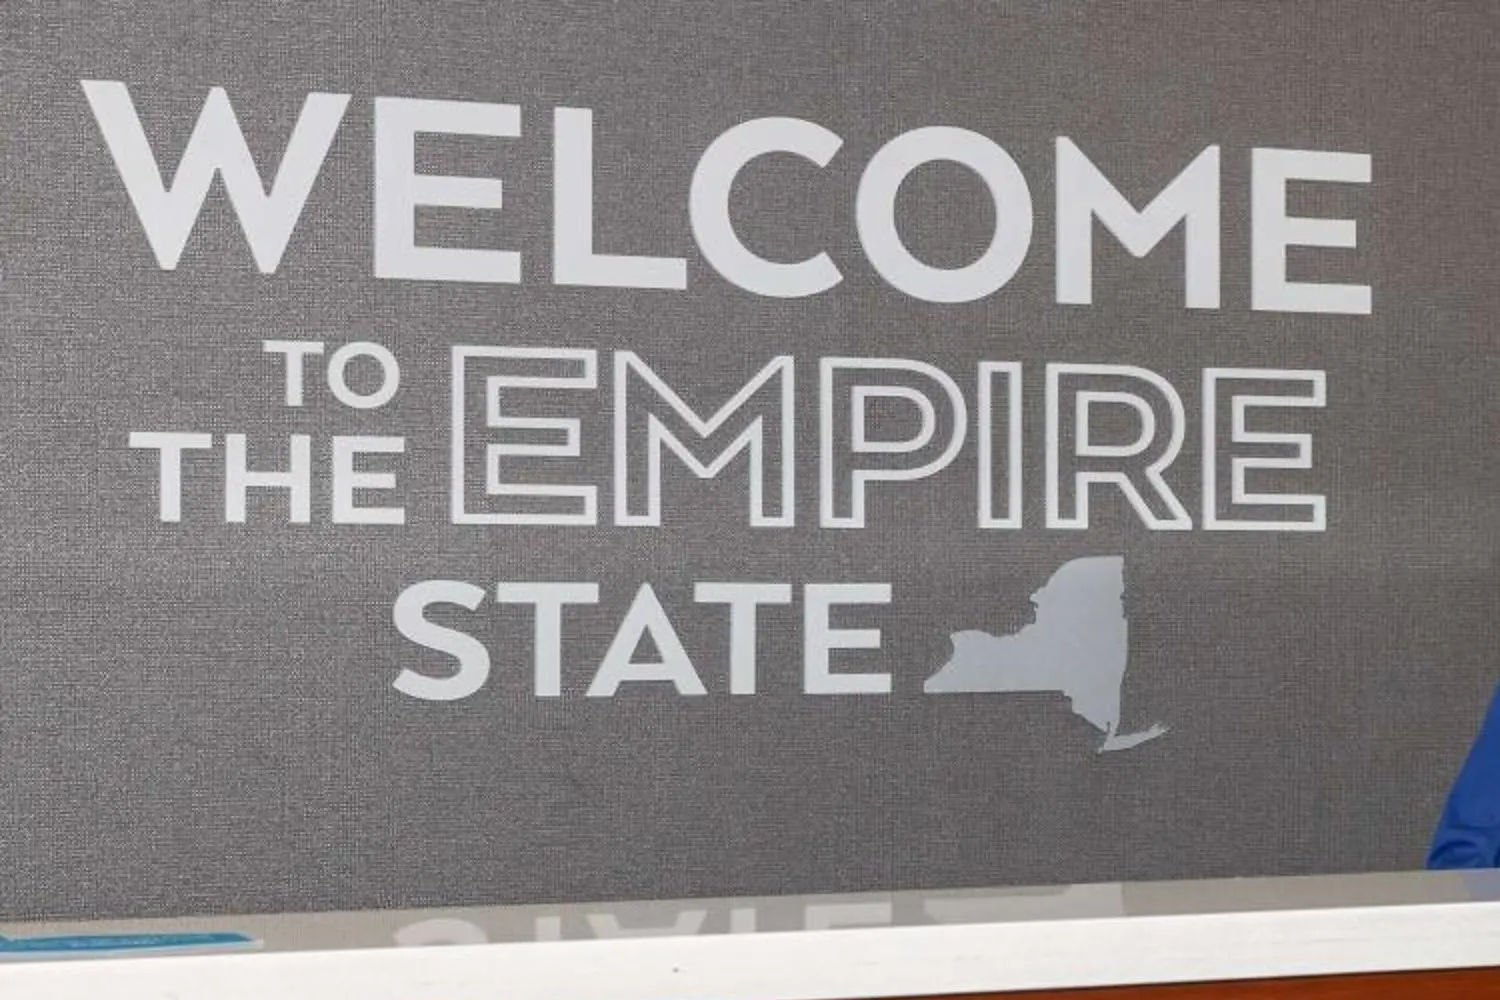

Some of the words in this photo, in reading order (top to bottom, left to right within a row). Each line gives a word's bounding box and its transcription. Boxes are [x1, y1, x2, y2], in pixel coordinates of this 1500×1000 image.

[79, 78, 1374, 316] WELCOME
[126, 427, 408, 529] THE
[447, 344, 1328, 533] EMPIRE
[261, 337, 402, 411] TO
[391, 579, 893, 702] STATE
